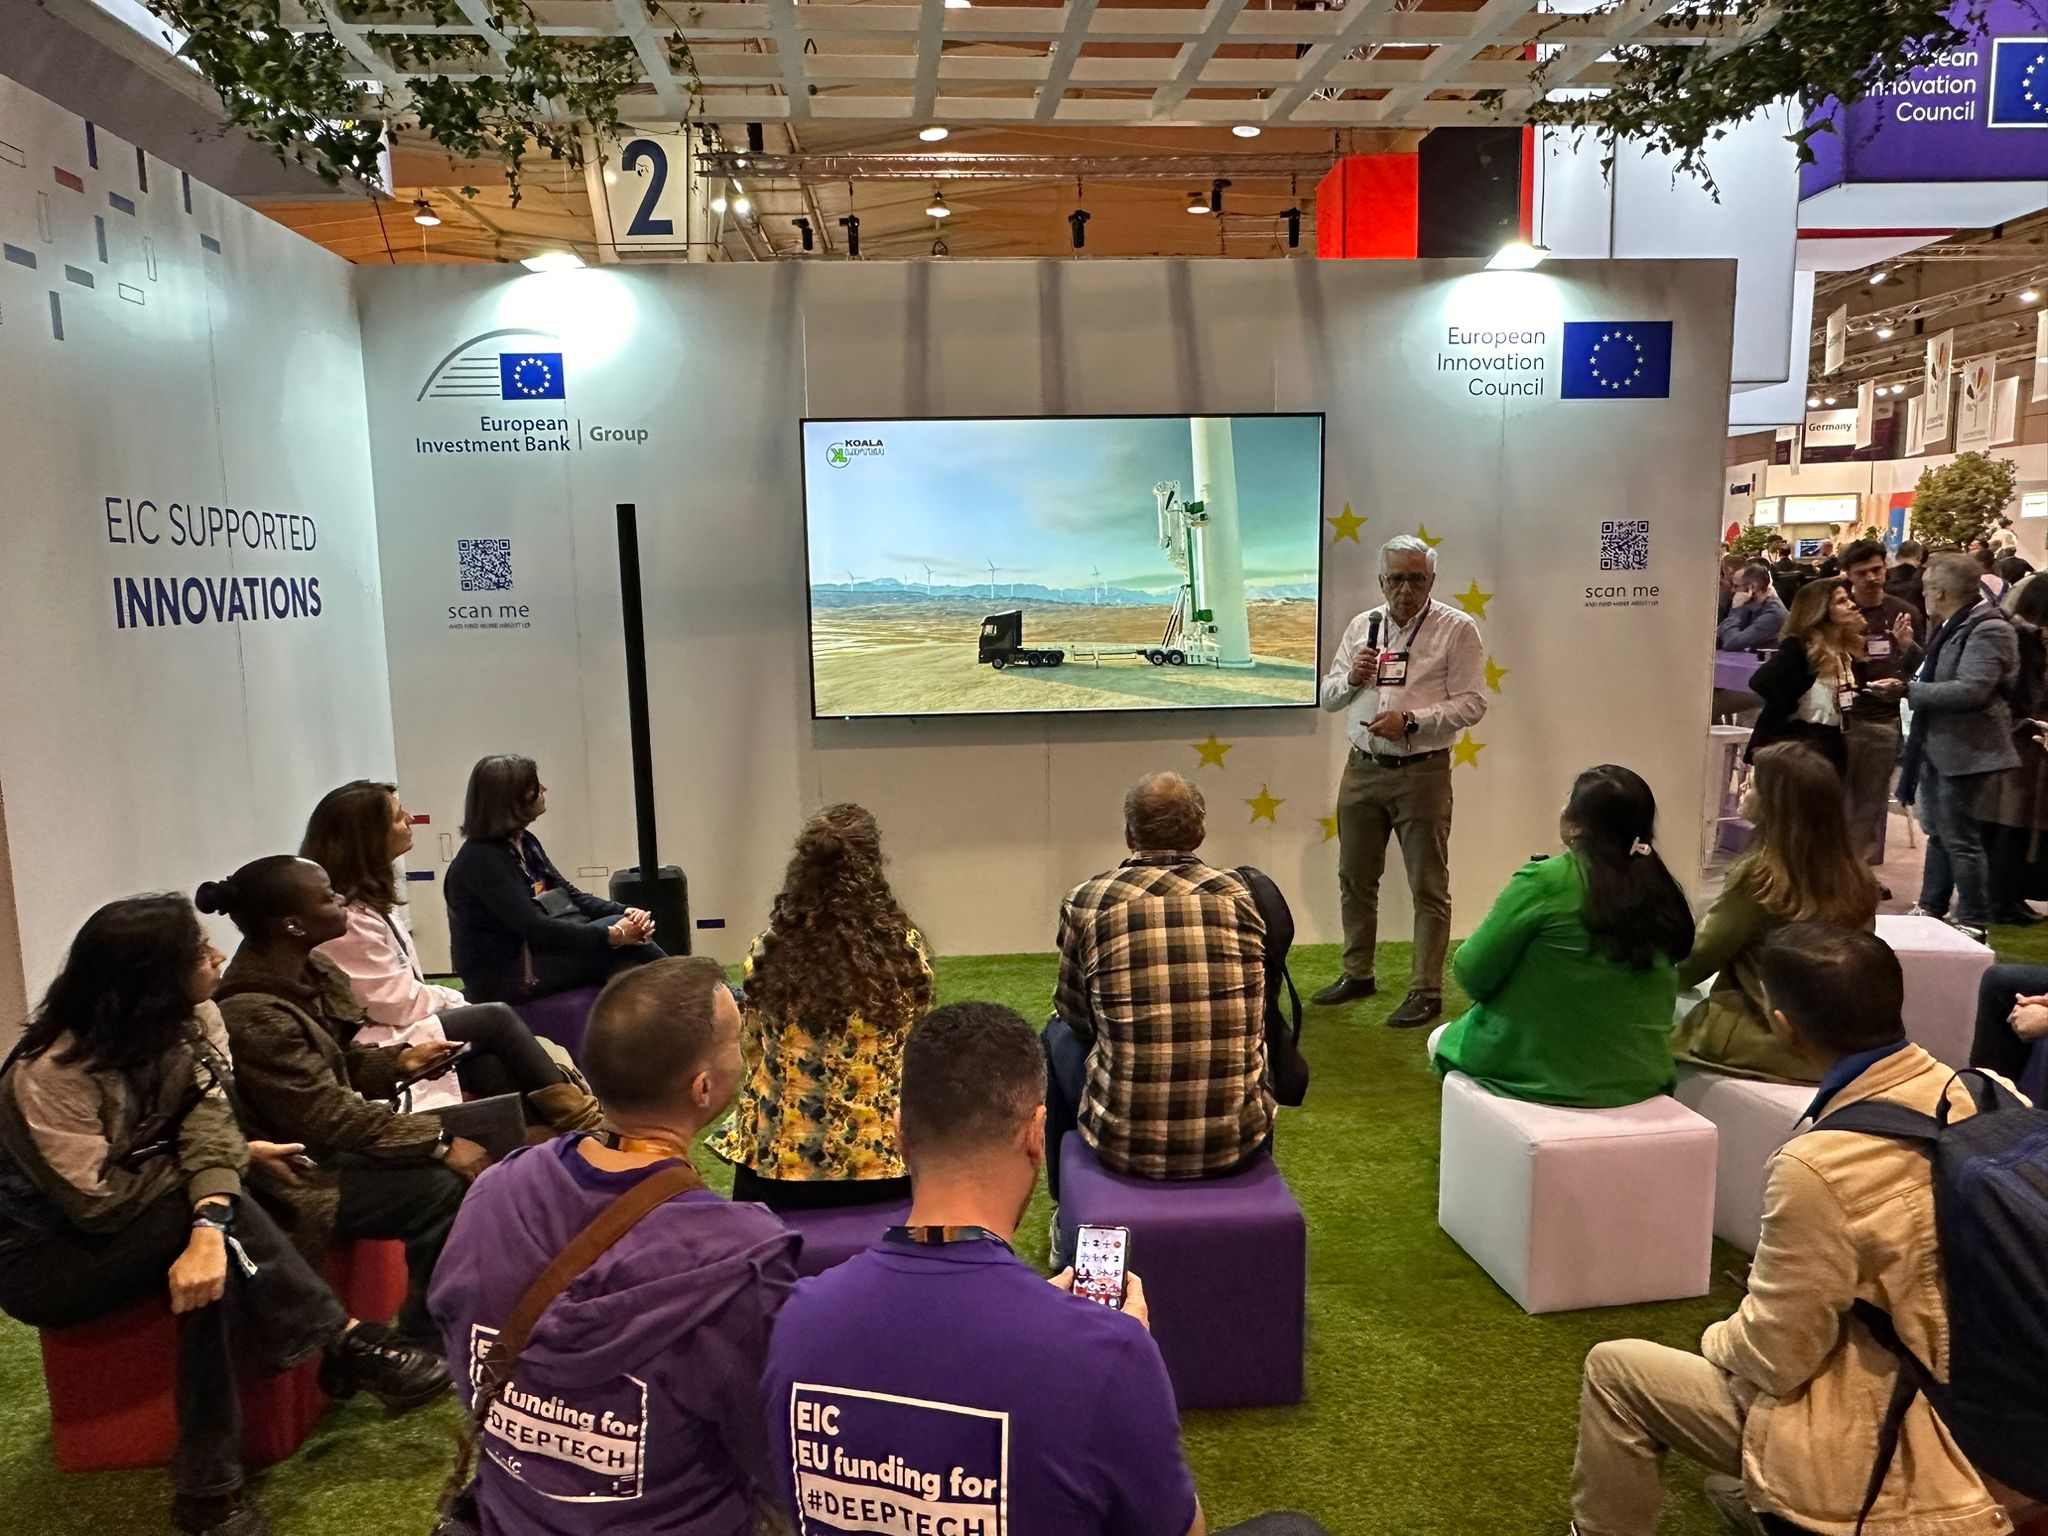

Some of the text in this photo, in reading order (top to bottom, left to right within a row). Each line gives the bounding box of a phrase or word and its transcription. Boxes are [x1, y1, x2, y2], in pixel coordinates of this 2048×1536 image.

[1895, 101, 1976, 121] Council
[622, 139, 674, 236] 2
[1448, 327, 1546, 348] European
[1437, 353, 1545, 371] Innovation
[1468, 378, 1544, 396] Council
[480, 416, 569, 434] European
[1808, 423, 1852, 432] Germany
[416, 435, 571, 453] Investment Bank
[589, 426, 649, 445] Group
[845, 439, 884, 447] KOALA
[105, 497, 317, 551] EIC SUPPORTED
[1585, 585, 1660, 598] scan me
[113, 577, 322, 628] INNOVATIONS
[448, 604, 530, 619] scan me
[503, 1381, 639, 1437] funding for
[797, 1401, 841, 1436] EIC
[489, 1409, 625, 1468] DEEPTECH
[797, 1439, 998, 1502] EU funding for
[807, 1488, 985, 1536] #DEEPTECH
